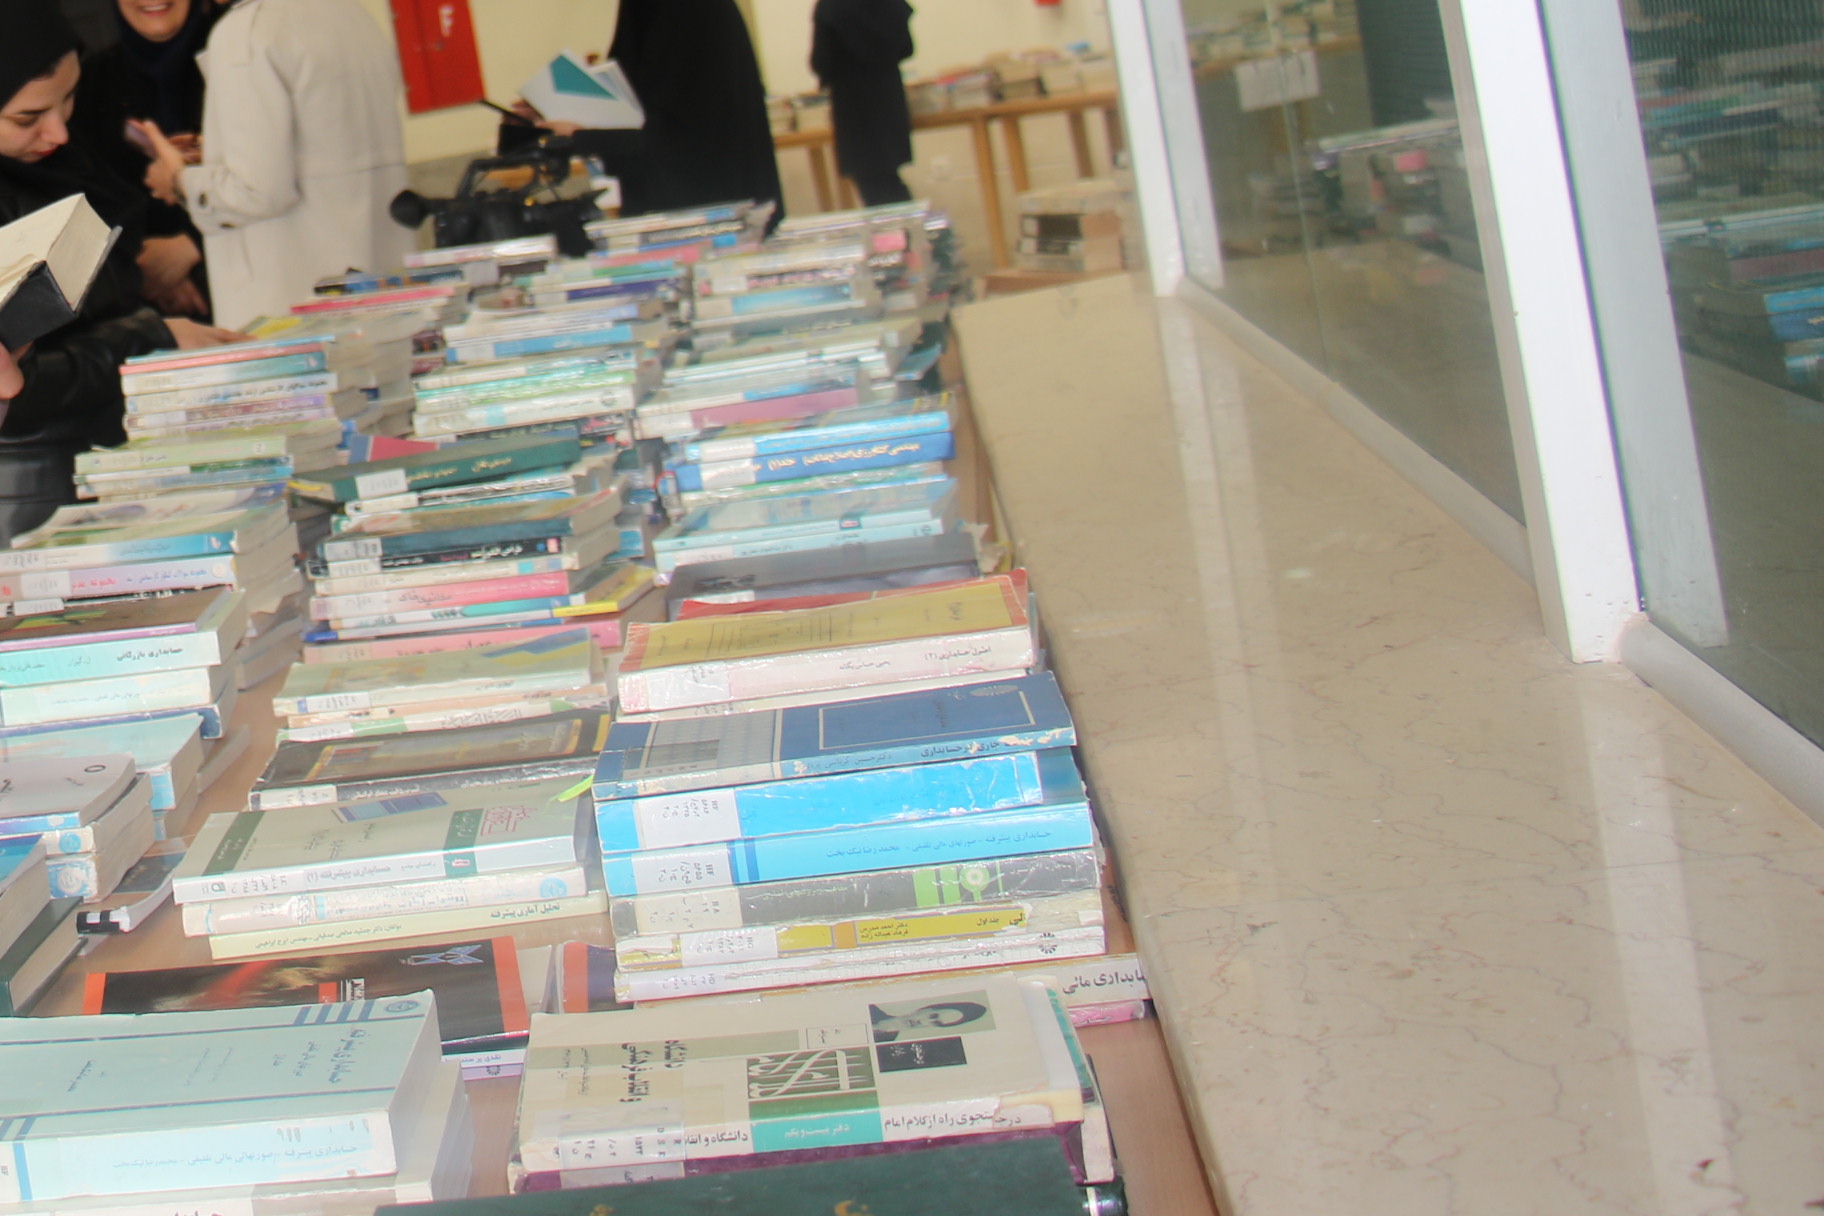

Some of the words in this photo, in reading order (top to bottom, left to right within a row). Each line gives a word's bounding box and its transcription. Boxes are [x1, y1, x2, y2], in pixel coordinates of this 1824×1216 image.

[1013, 831, 1052, 842] حسابداری
[319, 870, 352, 882] پیشرفته
[353, 865, 391, 879] حسابداری
[490, 908, 516, 920] پیشرفته
[516, 905, 539, 918] آماری
[540, 902, 561, 915] تحلیل
[1062, 975, 1091, 995] مالی
[883, 1117, 906, 1131] امام
[906, 1115, 928, 1131] کلام
[937, 1113, 956, 1128] راه
[710, 1130, 749, 1145] دانشگاه
[314, 1144, 358, 1157] حسابداری
